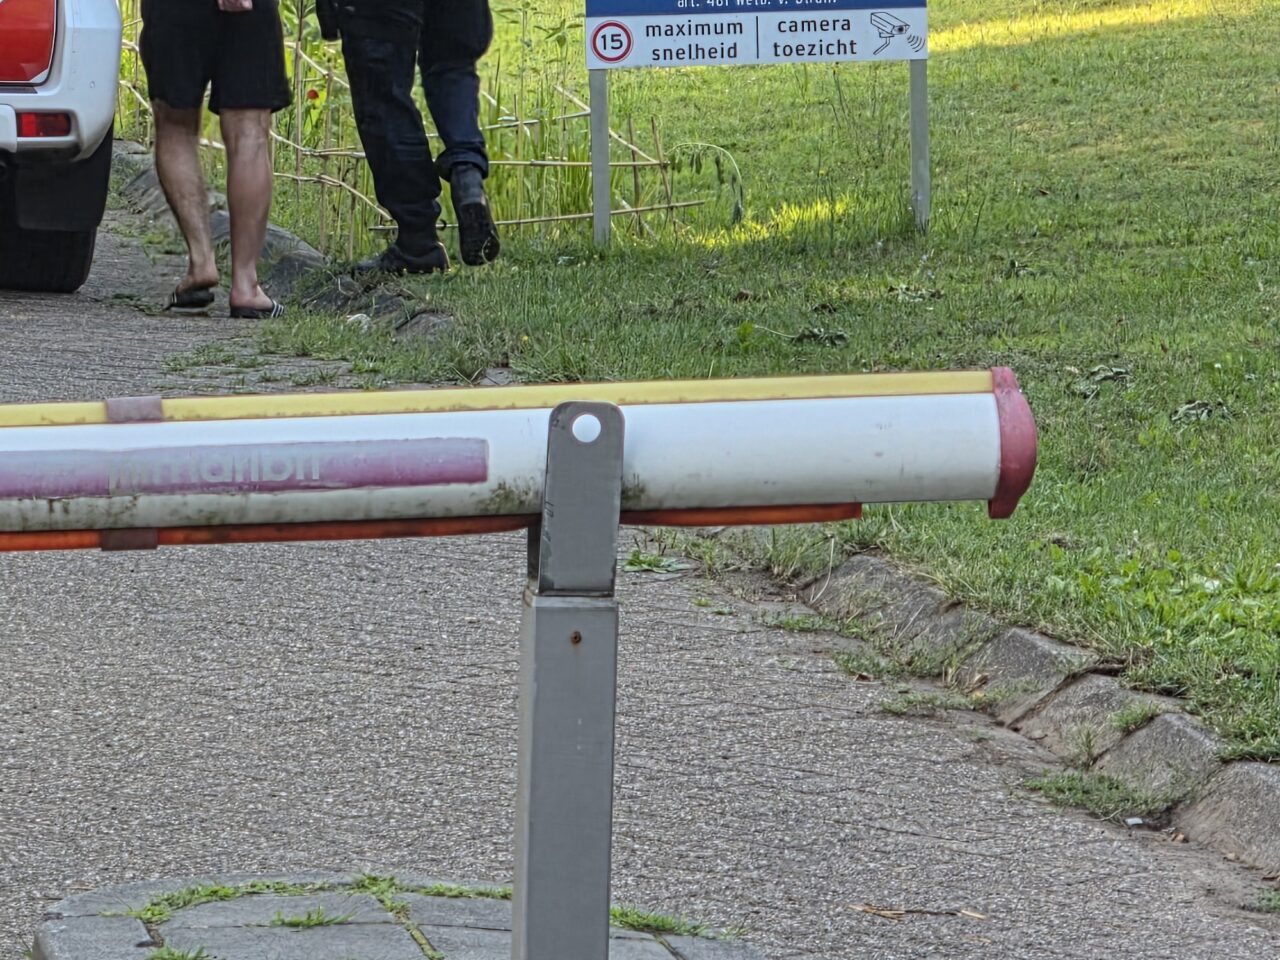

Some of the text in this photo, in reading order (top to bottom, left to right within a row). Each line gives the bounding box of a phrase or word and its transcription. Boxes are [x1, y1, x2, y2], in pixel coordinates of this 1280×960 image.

[645, 19, 743, 37] maximum
[778, 18, 851, 33] camera
[600, 33, 624, 51] 15
[773, 39, 858, 57] toezicht
[652, 43, 738, 61] snelheid
